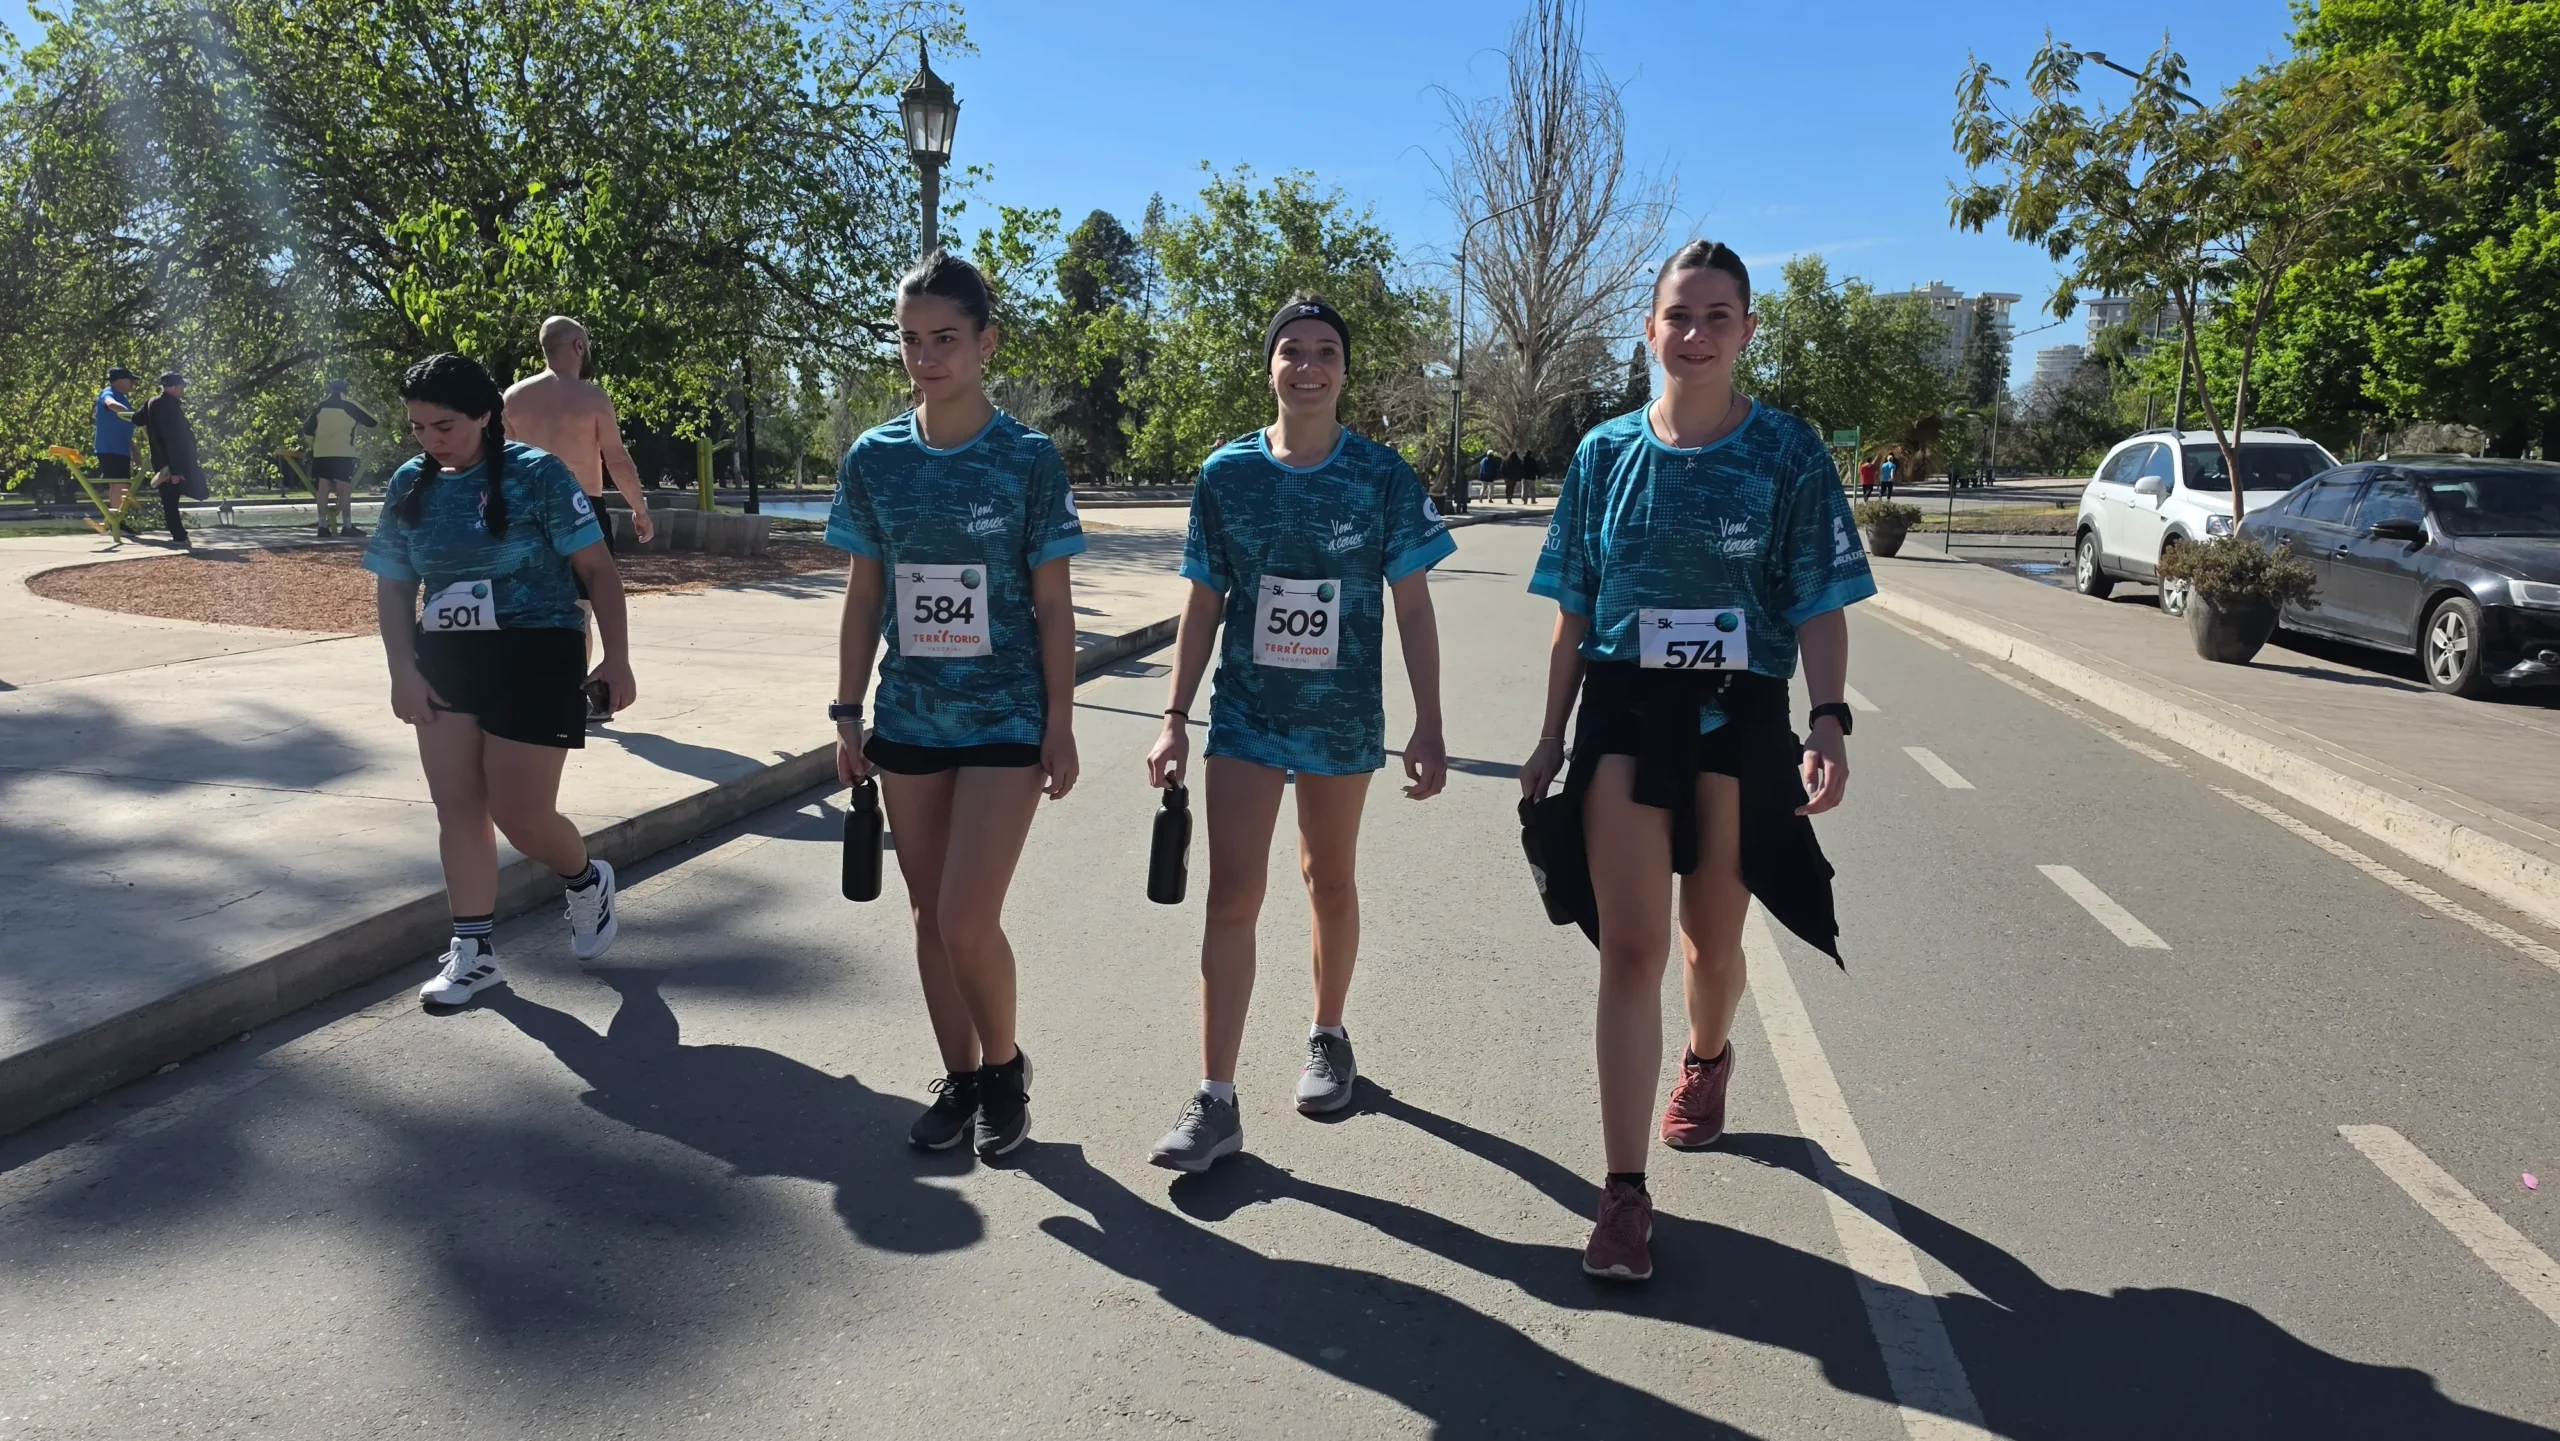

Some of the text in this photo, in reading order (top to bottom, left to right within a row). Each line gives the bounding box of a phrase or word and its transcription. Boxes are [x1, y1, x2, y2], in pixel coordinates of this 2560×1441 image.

[911, 572, 926, 583] 5k
[1272, 584, 1285, 597] 5k
[438, 604, 480, 629] 501
[913, 595, 975, 625] 584
[1266, 606, 1328, 638] 509
[1657, 617, 1673, 630] 5k
[1663, 640, 1727, 669] 574
